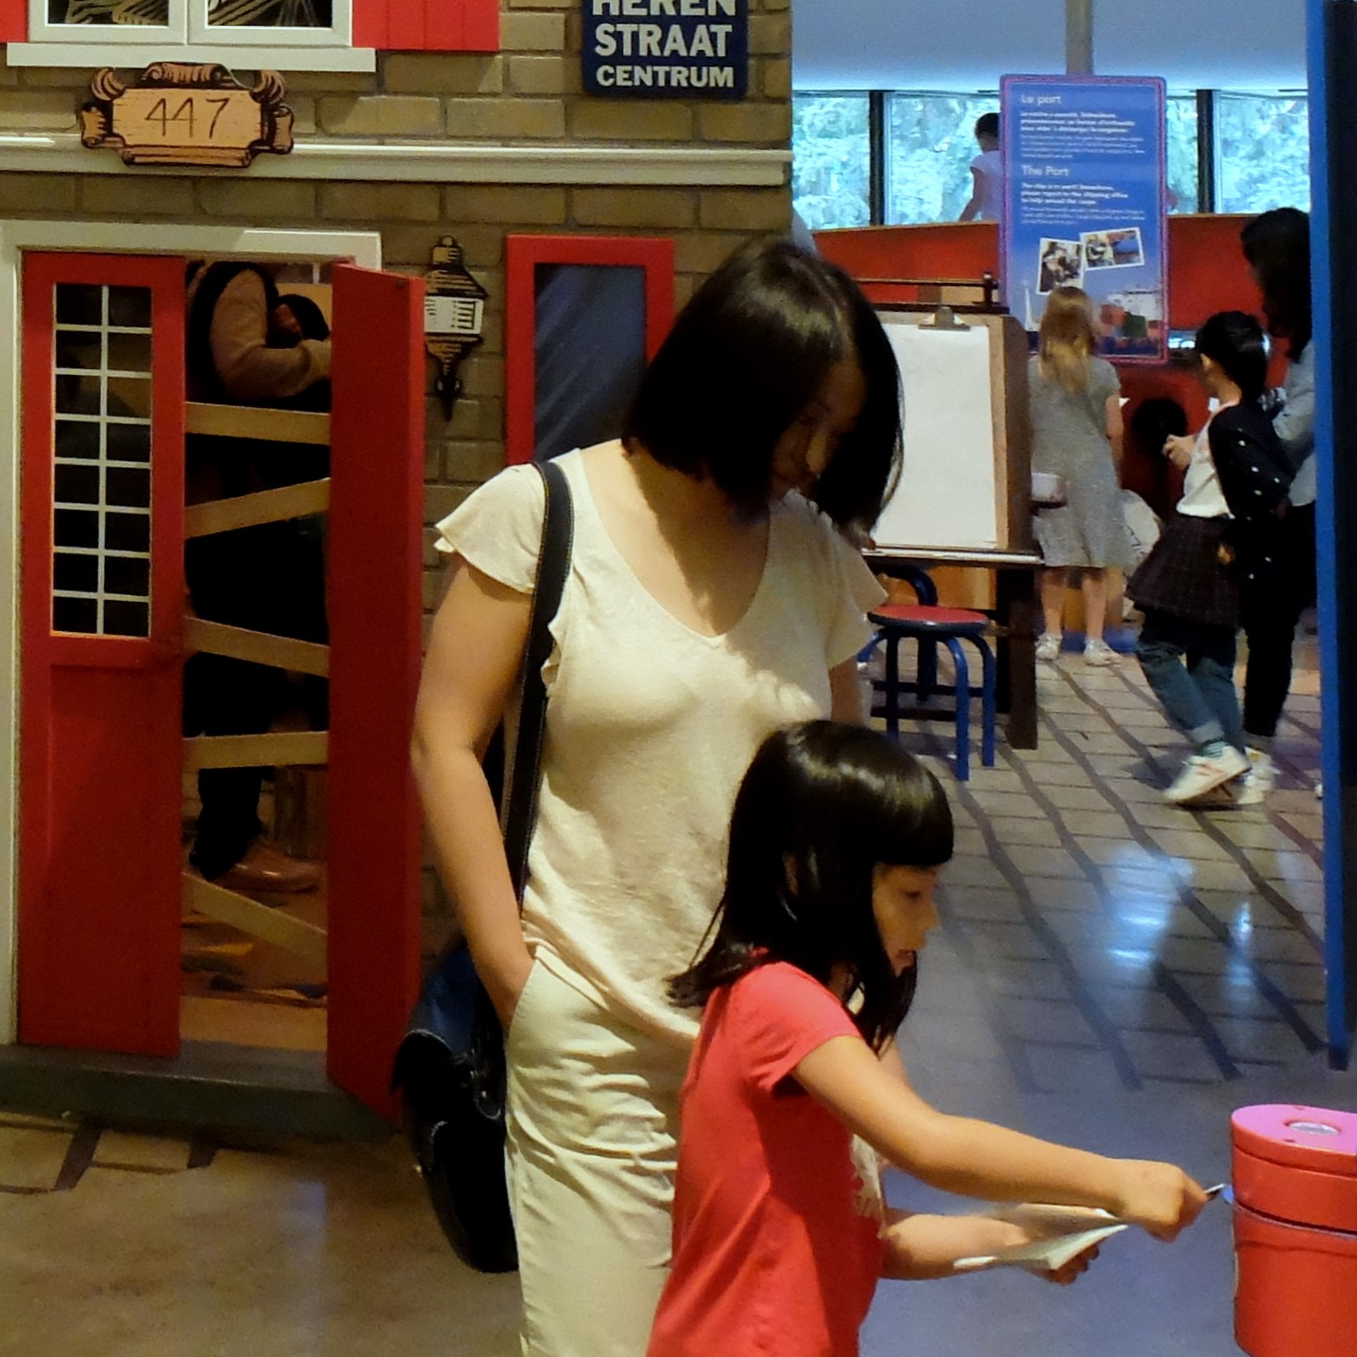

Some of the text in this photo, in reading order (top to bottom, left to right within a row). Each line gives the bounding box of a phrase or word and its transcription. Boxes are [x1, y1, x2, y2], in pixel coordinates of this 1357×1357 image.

[595, 23, 733, 57] STRAAT
[596, 65, 735, 88] CENTRUM
[1037, 95, 1062, 107] port
[145, 97, 231, 139] 447
[1022, 164, 1069, 177] The Port
